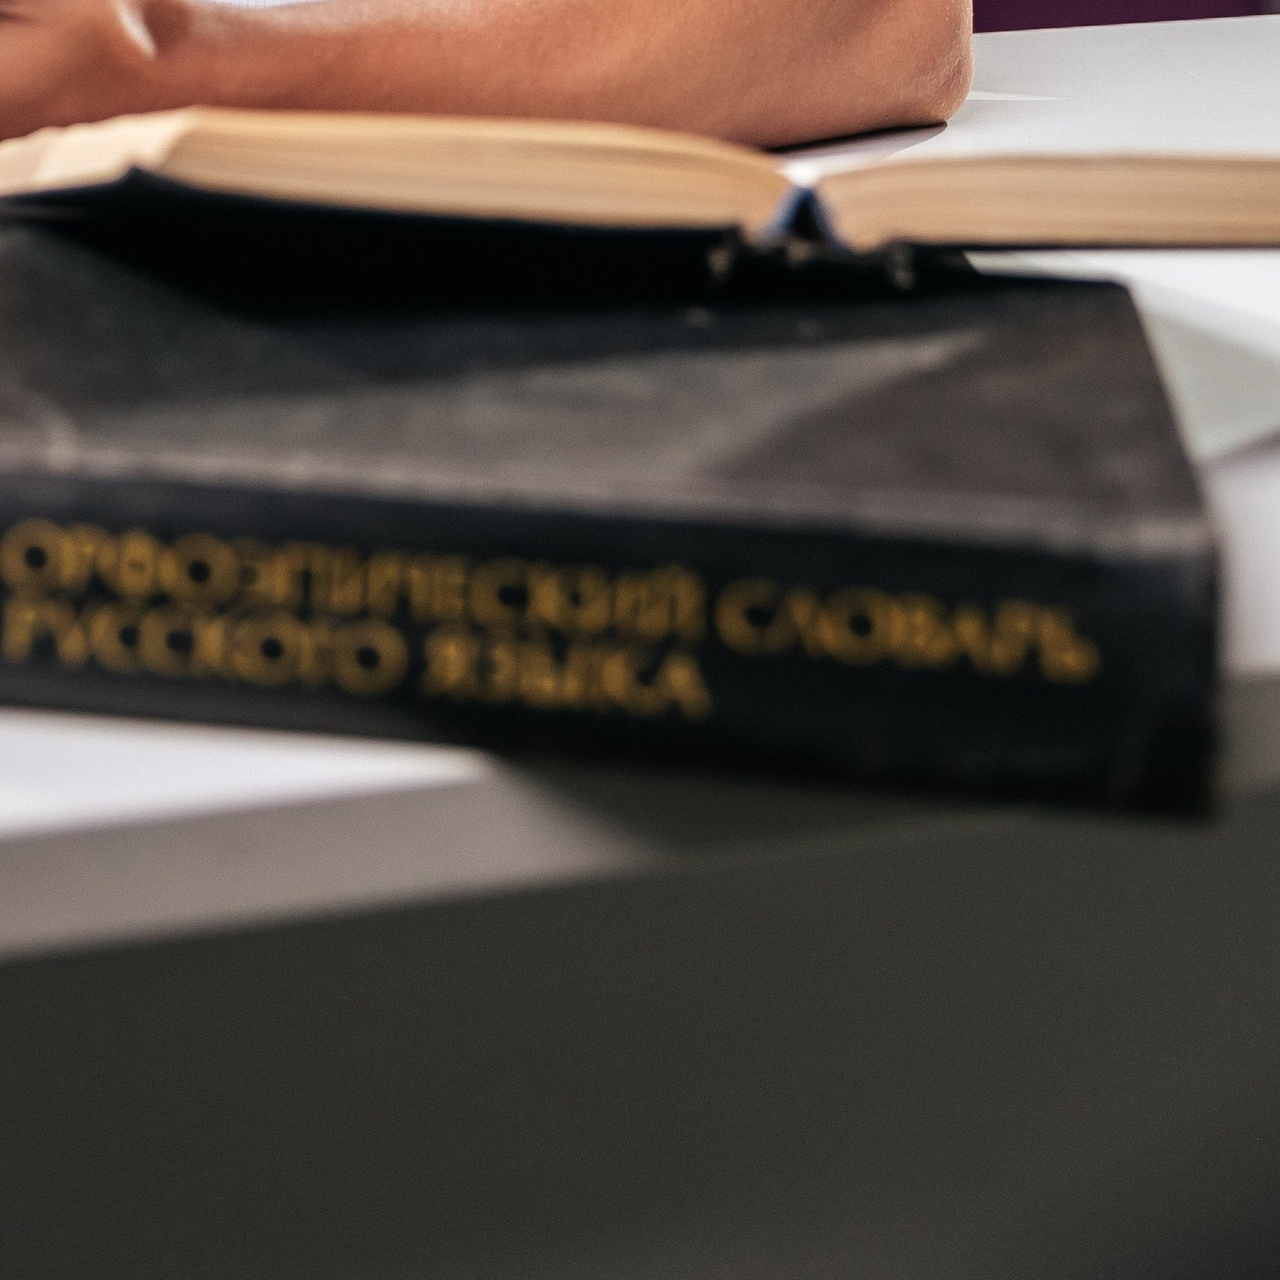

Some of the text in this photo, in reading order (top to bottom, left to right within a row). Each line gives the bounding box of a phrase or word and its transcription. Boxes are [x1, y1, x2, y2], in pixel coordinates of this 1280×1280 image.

[2, 596, 712, 716] РУССКОГО ЯЗЫКА
[716, 578, 1100, 683] СЛОВАРЬ
